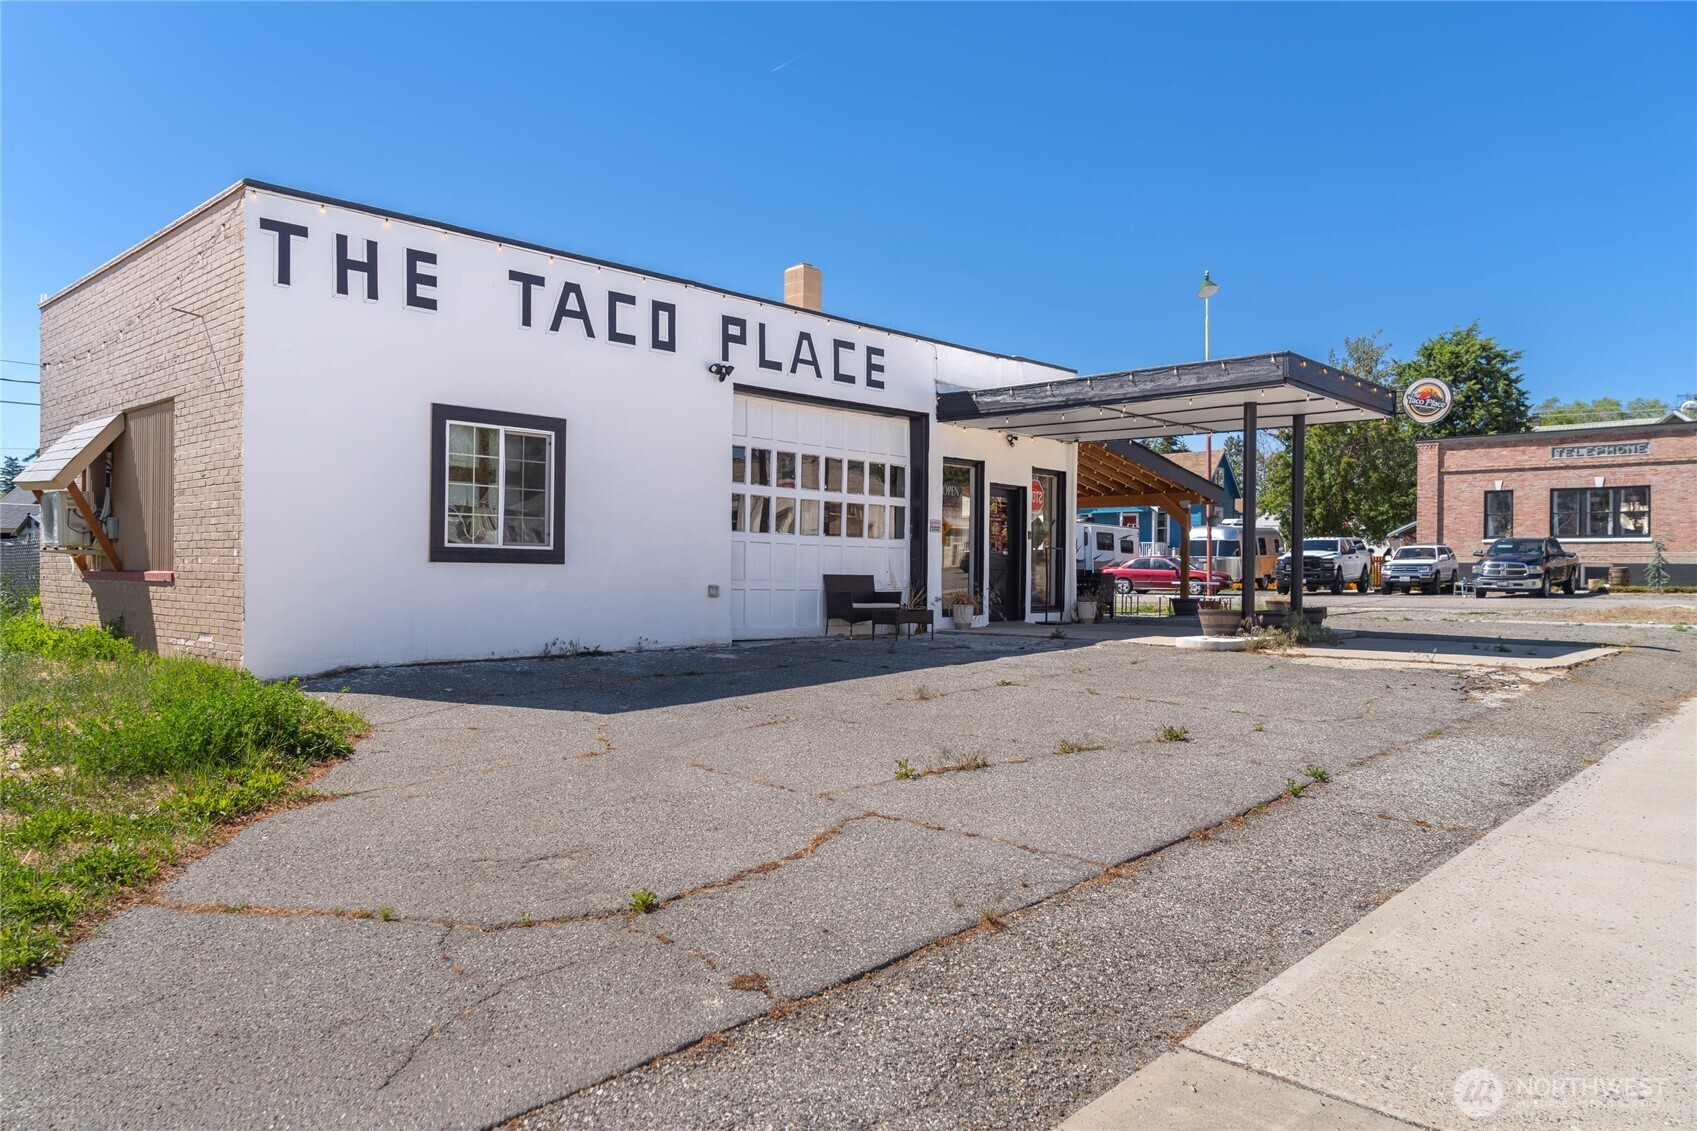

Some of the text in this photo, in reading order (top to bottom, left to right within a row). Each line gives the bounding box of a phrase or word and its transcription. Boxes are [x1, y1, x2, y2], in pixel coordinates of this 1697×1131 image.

[259, 217, 885, 390] THE TACO PLACE
[1408, 395, 1446, 408] Taco Place
[1553, 443, 1647, 458] TELEPHONE
[943, 484, 959, 496] OPEN
